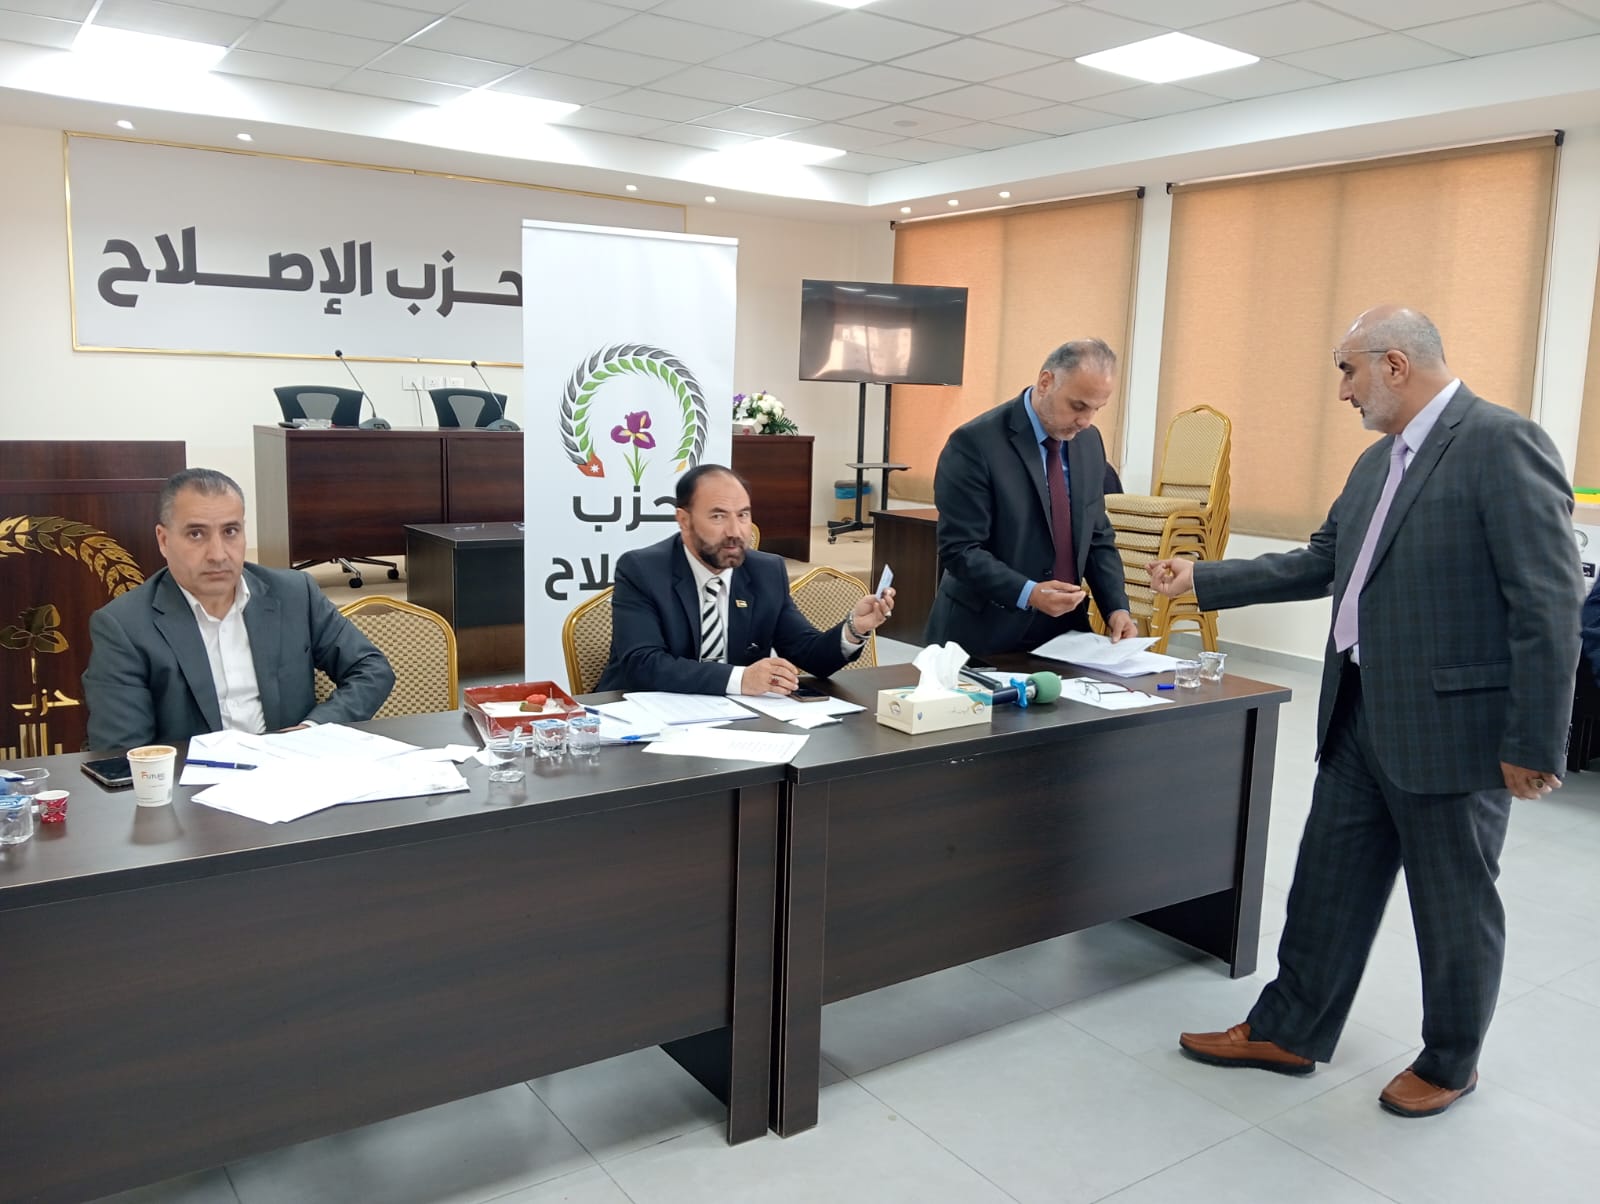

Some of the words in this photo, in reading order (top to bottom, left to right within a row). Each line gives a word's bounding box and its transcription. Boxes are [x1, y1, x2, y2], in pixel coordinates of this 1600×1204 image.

[97, 226, 373, 315] الإصلاح
[386, 250, 523, 318] حزب
[572, 485, 677, 532] حزب
[12, 688, 80, 716] حزب
